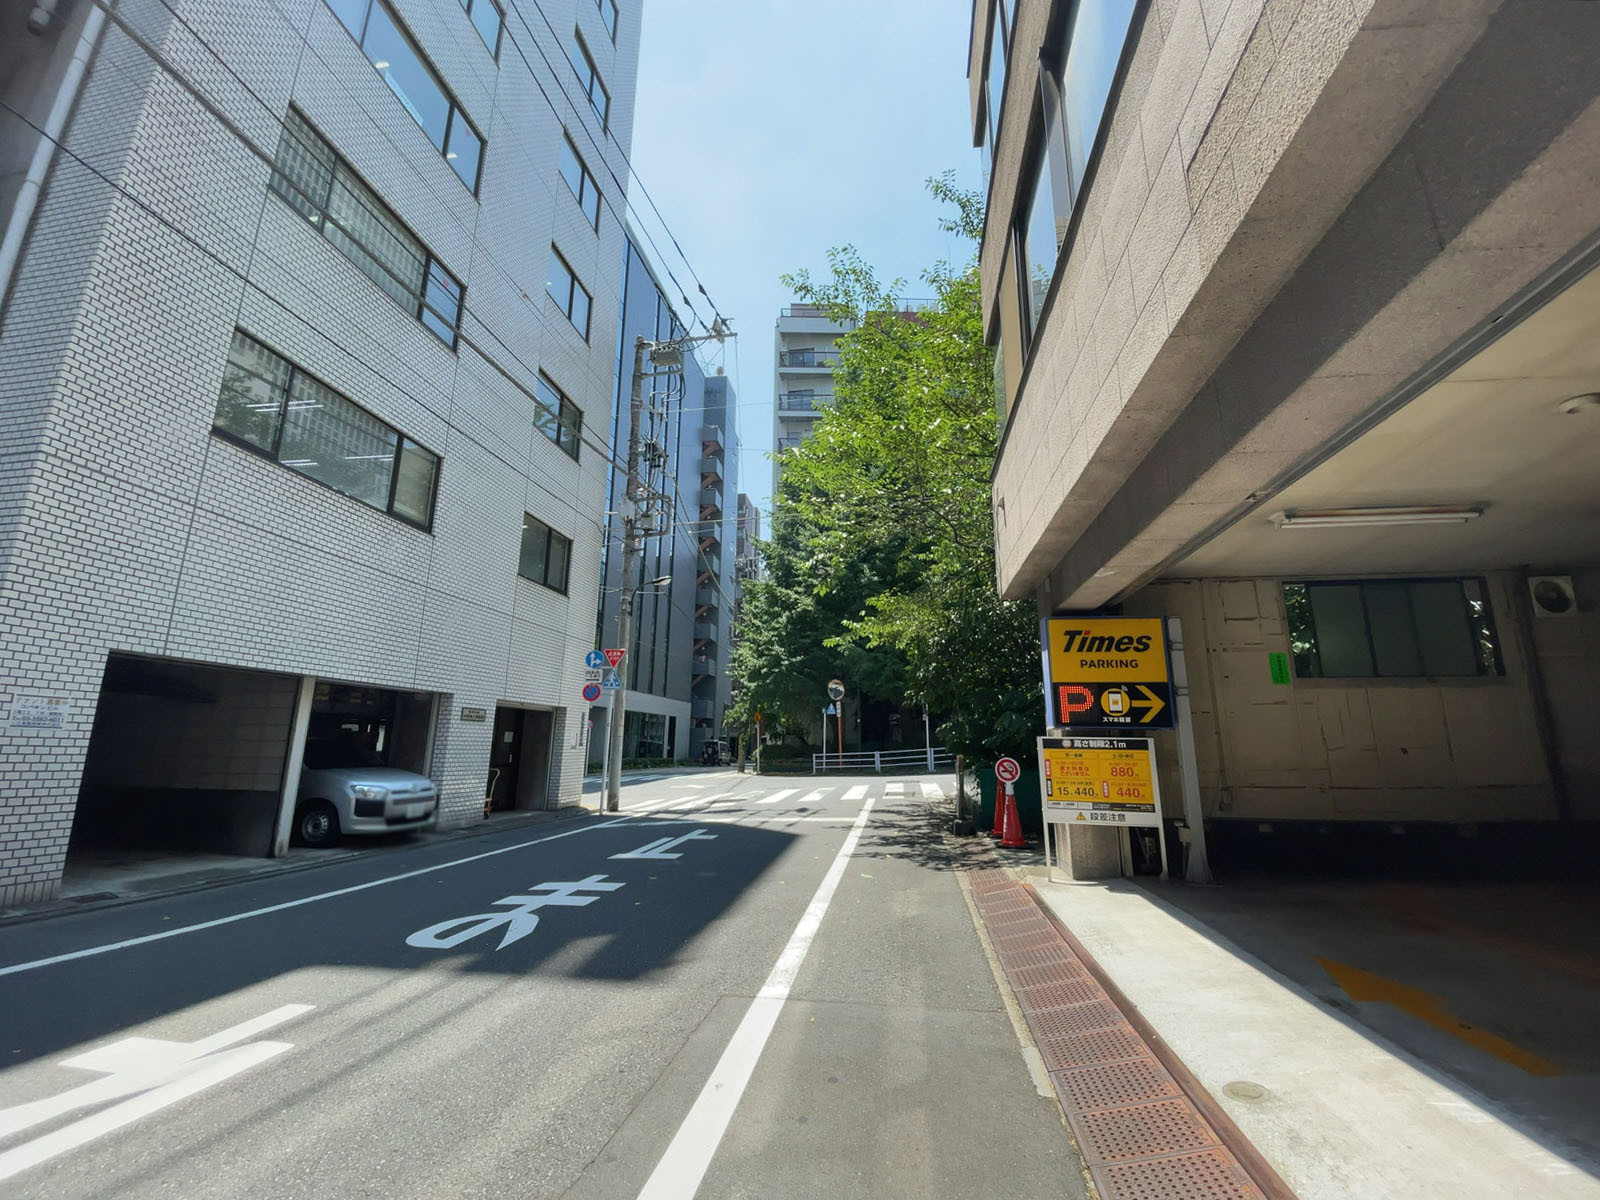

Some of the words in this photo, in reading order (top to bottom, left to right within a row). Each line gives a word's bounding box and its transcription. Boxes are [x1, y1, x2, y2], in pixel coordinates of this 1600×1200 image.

[1063, 629, 1153, 653] Times
[1080, 659, 1139, 669] PARKING
[1059, 685, 1094, 723] P
[1110, 767, 1139, 777] 880
[1116, 787, 1145, 799] 440
